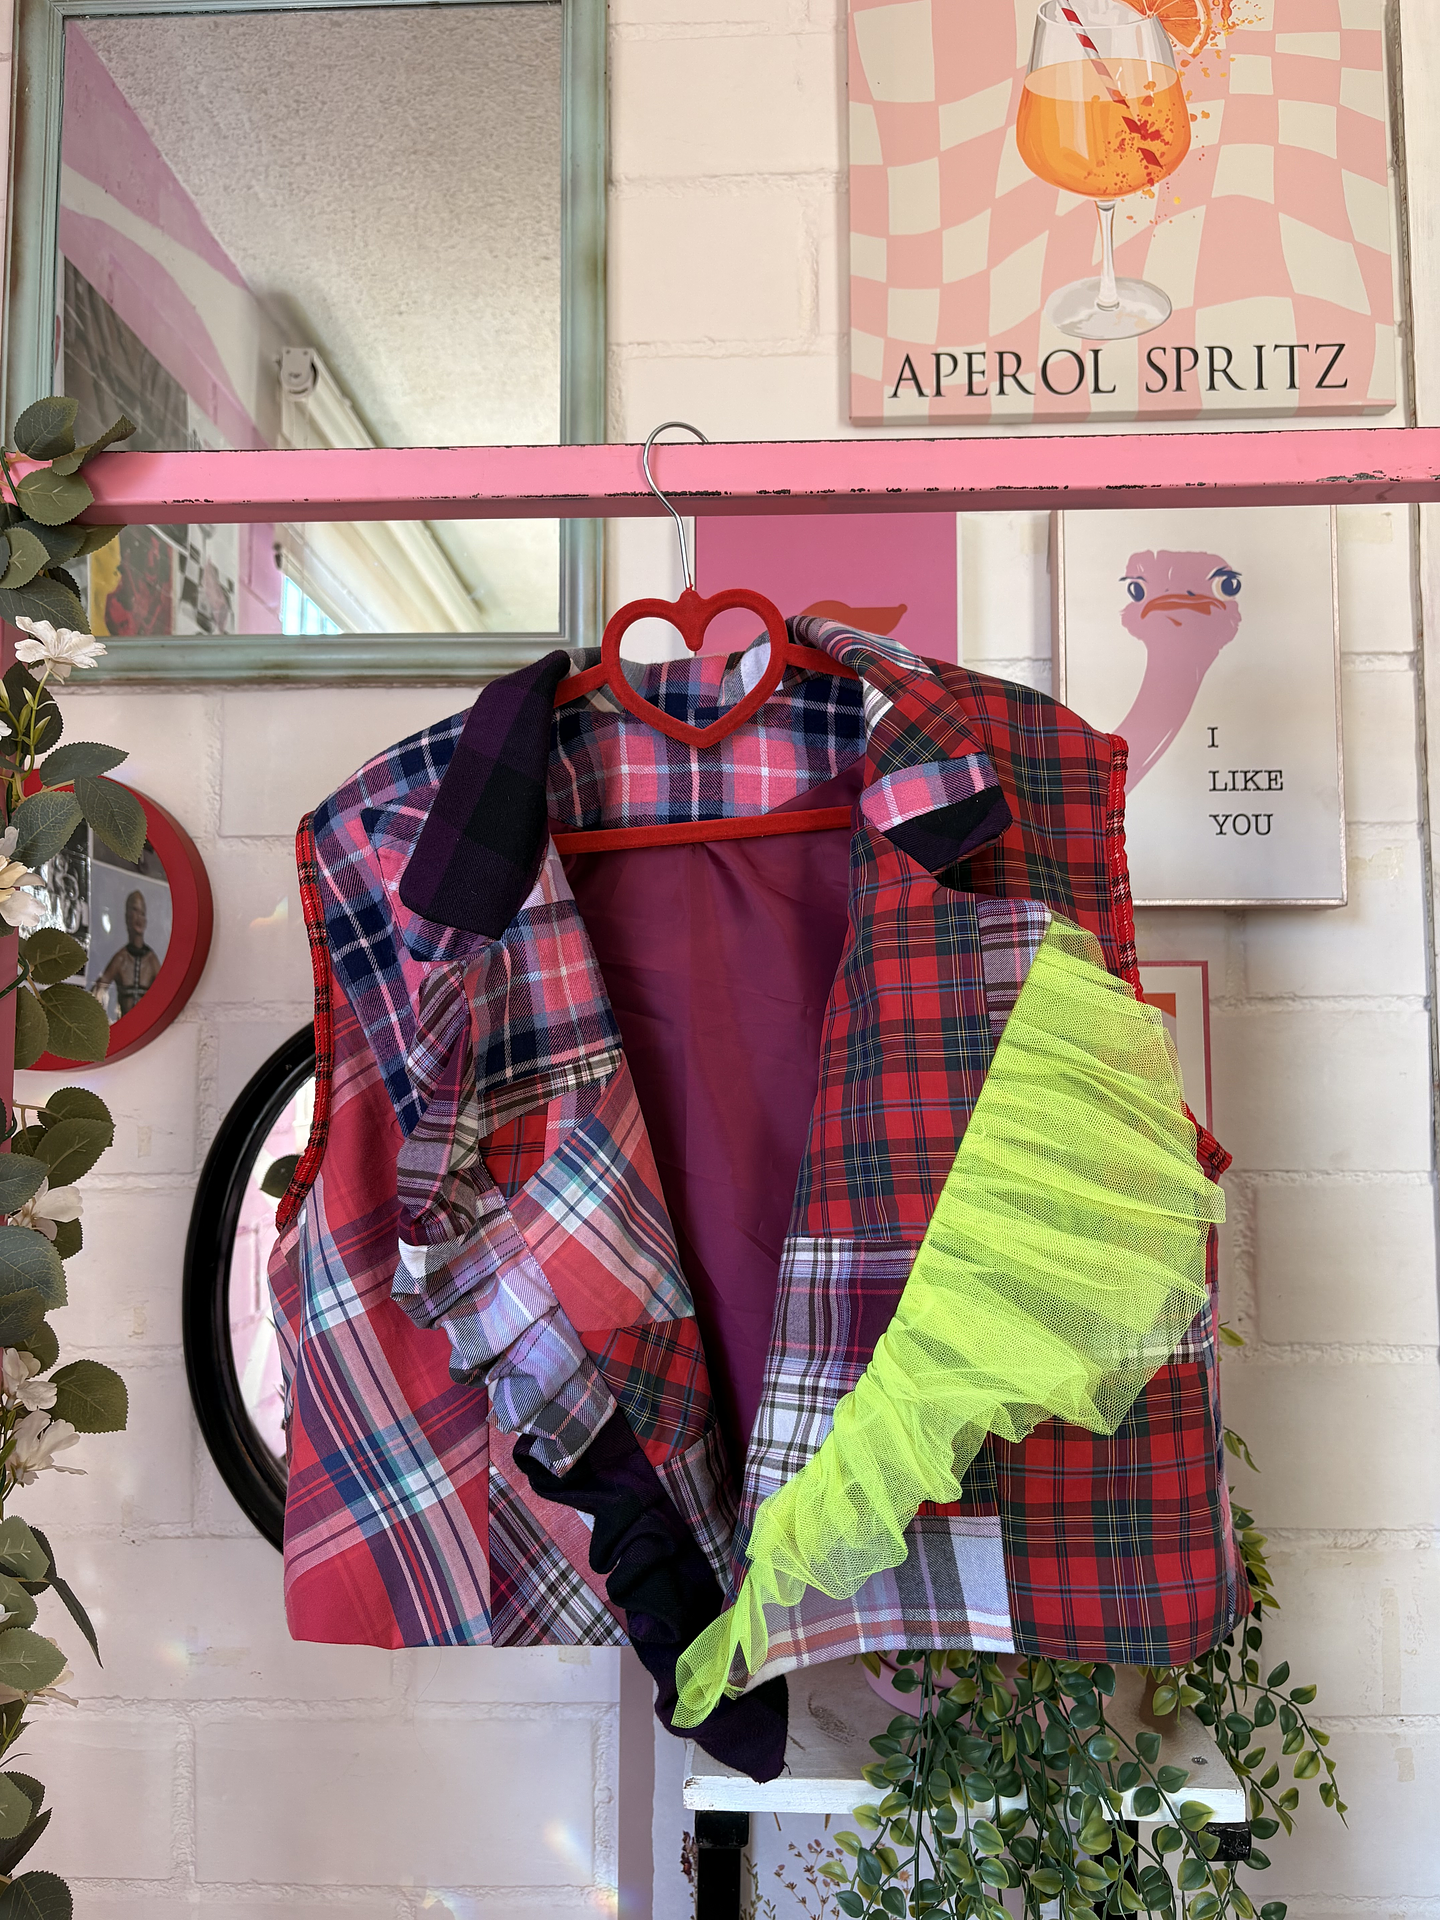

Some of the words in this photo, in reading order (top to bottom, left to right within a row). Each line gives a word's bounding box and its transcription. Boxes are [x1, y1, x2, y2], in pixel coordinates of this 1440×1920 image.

[888, 347, 1117, 398] APEROL
[1145, 343, 1350, 393] SPRITZ
[1207, 727, 1219, 748] I
[1208, 770, 1284, 792] LIKE
[1209, 813, 1274, 836] YOU
